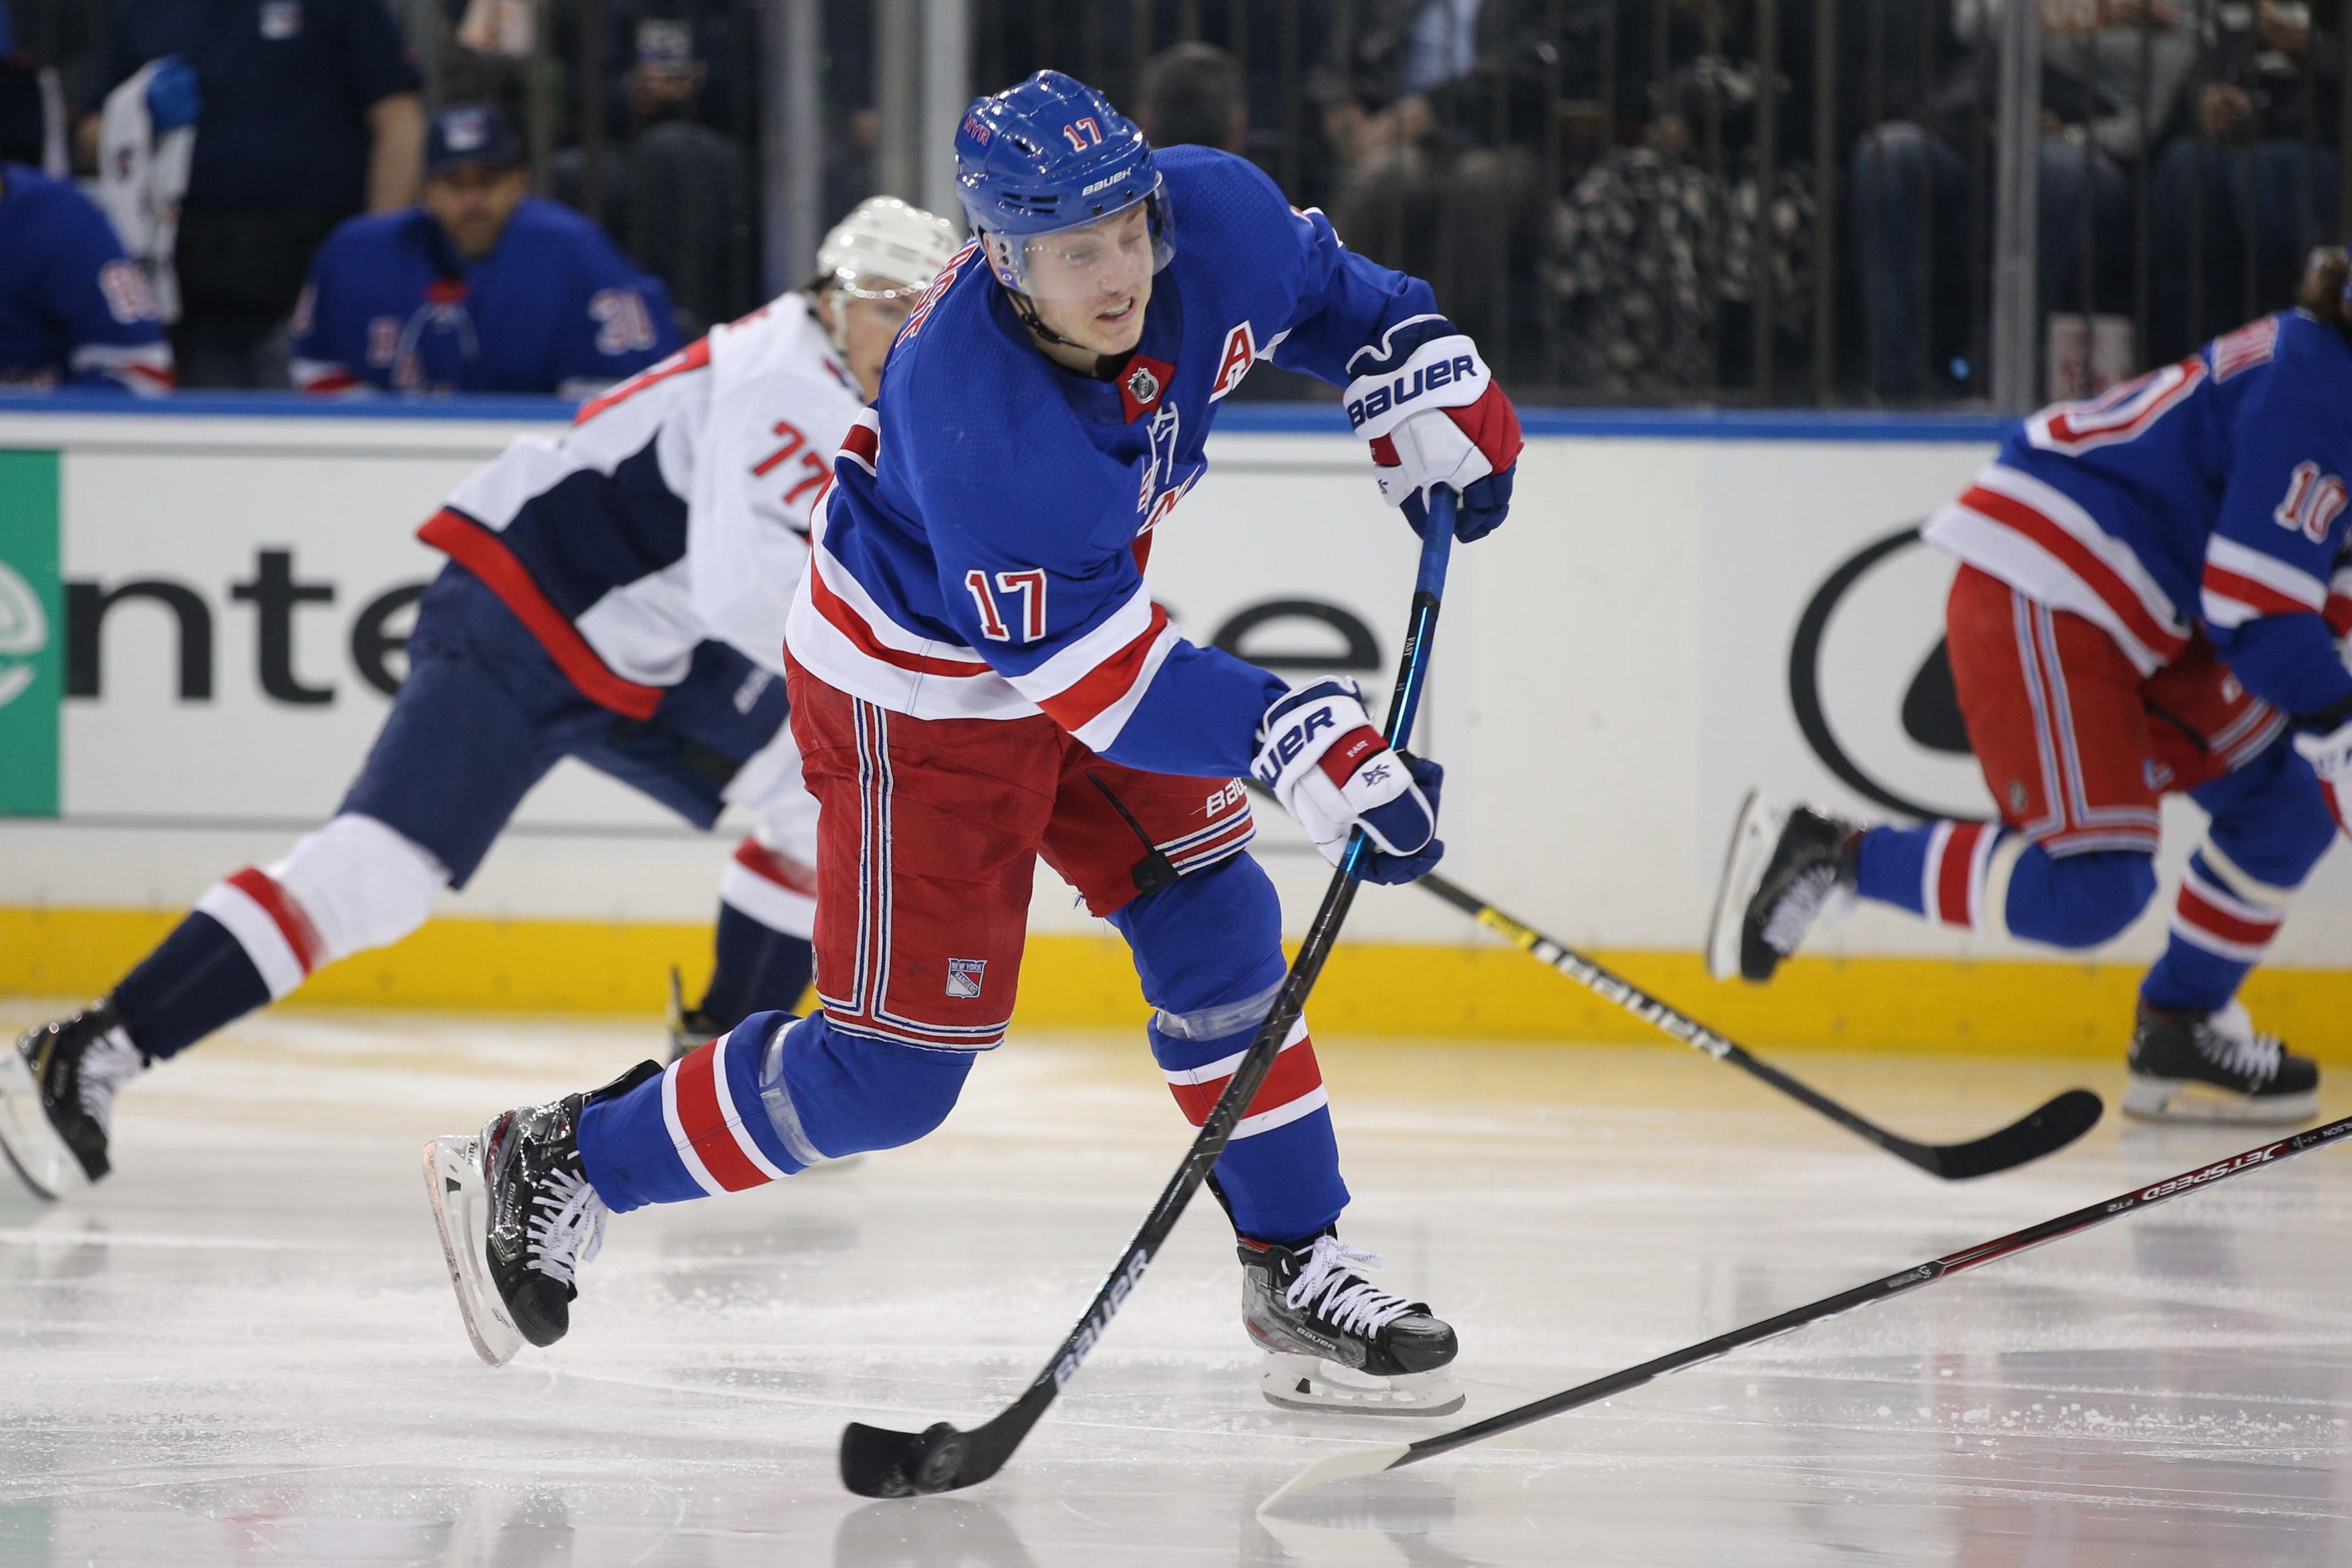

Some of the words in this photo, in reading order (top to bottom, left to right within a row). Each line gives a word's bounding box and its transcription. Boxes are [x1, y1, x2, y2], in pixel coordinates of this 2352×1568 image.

[963, 114, 990, 146] NYR
[1063, 117, 1102, 153] 17
[895, 236, 980, 348] AST
[1208, 320, 1256, 404] A
[752, 421, 831, 504] 77
[2274, 460, 2349, 544] 10
[964, 567, 1047, 643] 17
[1258, 706, 1335, 788] UER
[1347, 740, 1369, 758] FAST
[951, 961, 965, 970] NEW
[966, 963, 982, 971] YORK
[954, 971, 978, 995] RANGERS
[2141, 1144, 2283, 1202] JETSPEED
[2107, 1198, 2135, 1213] FT2
